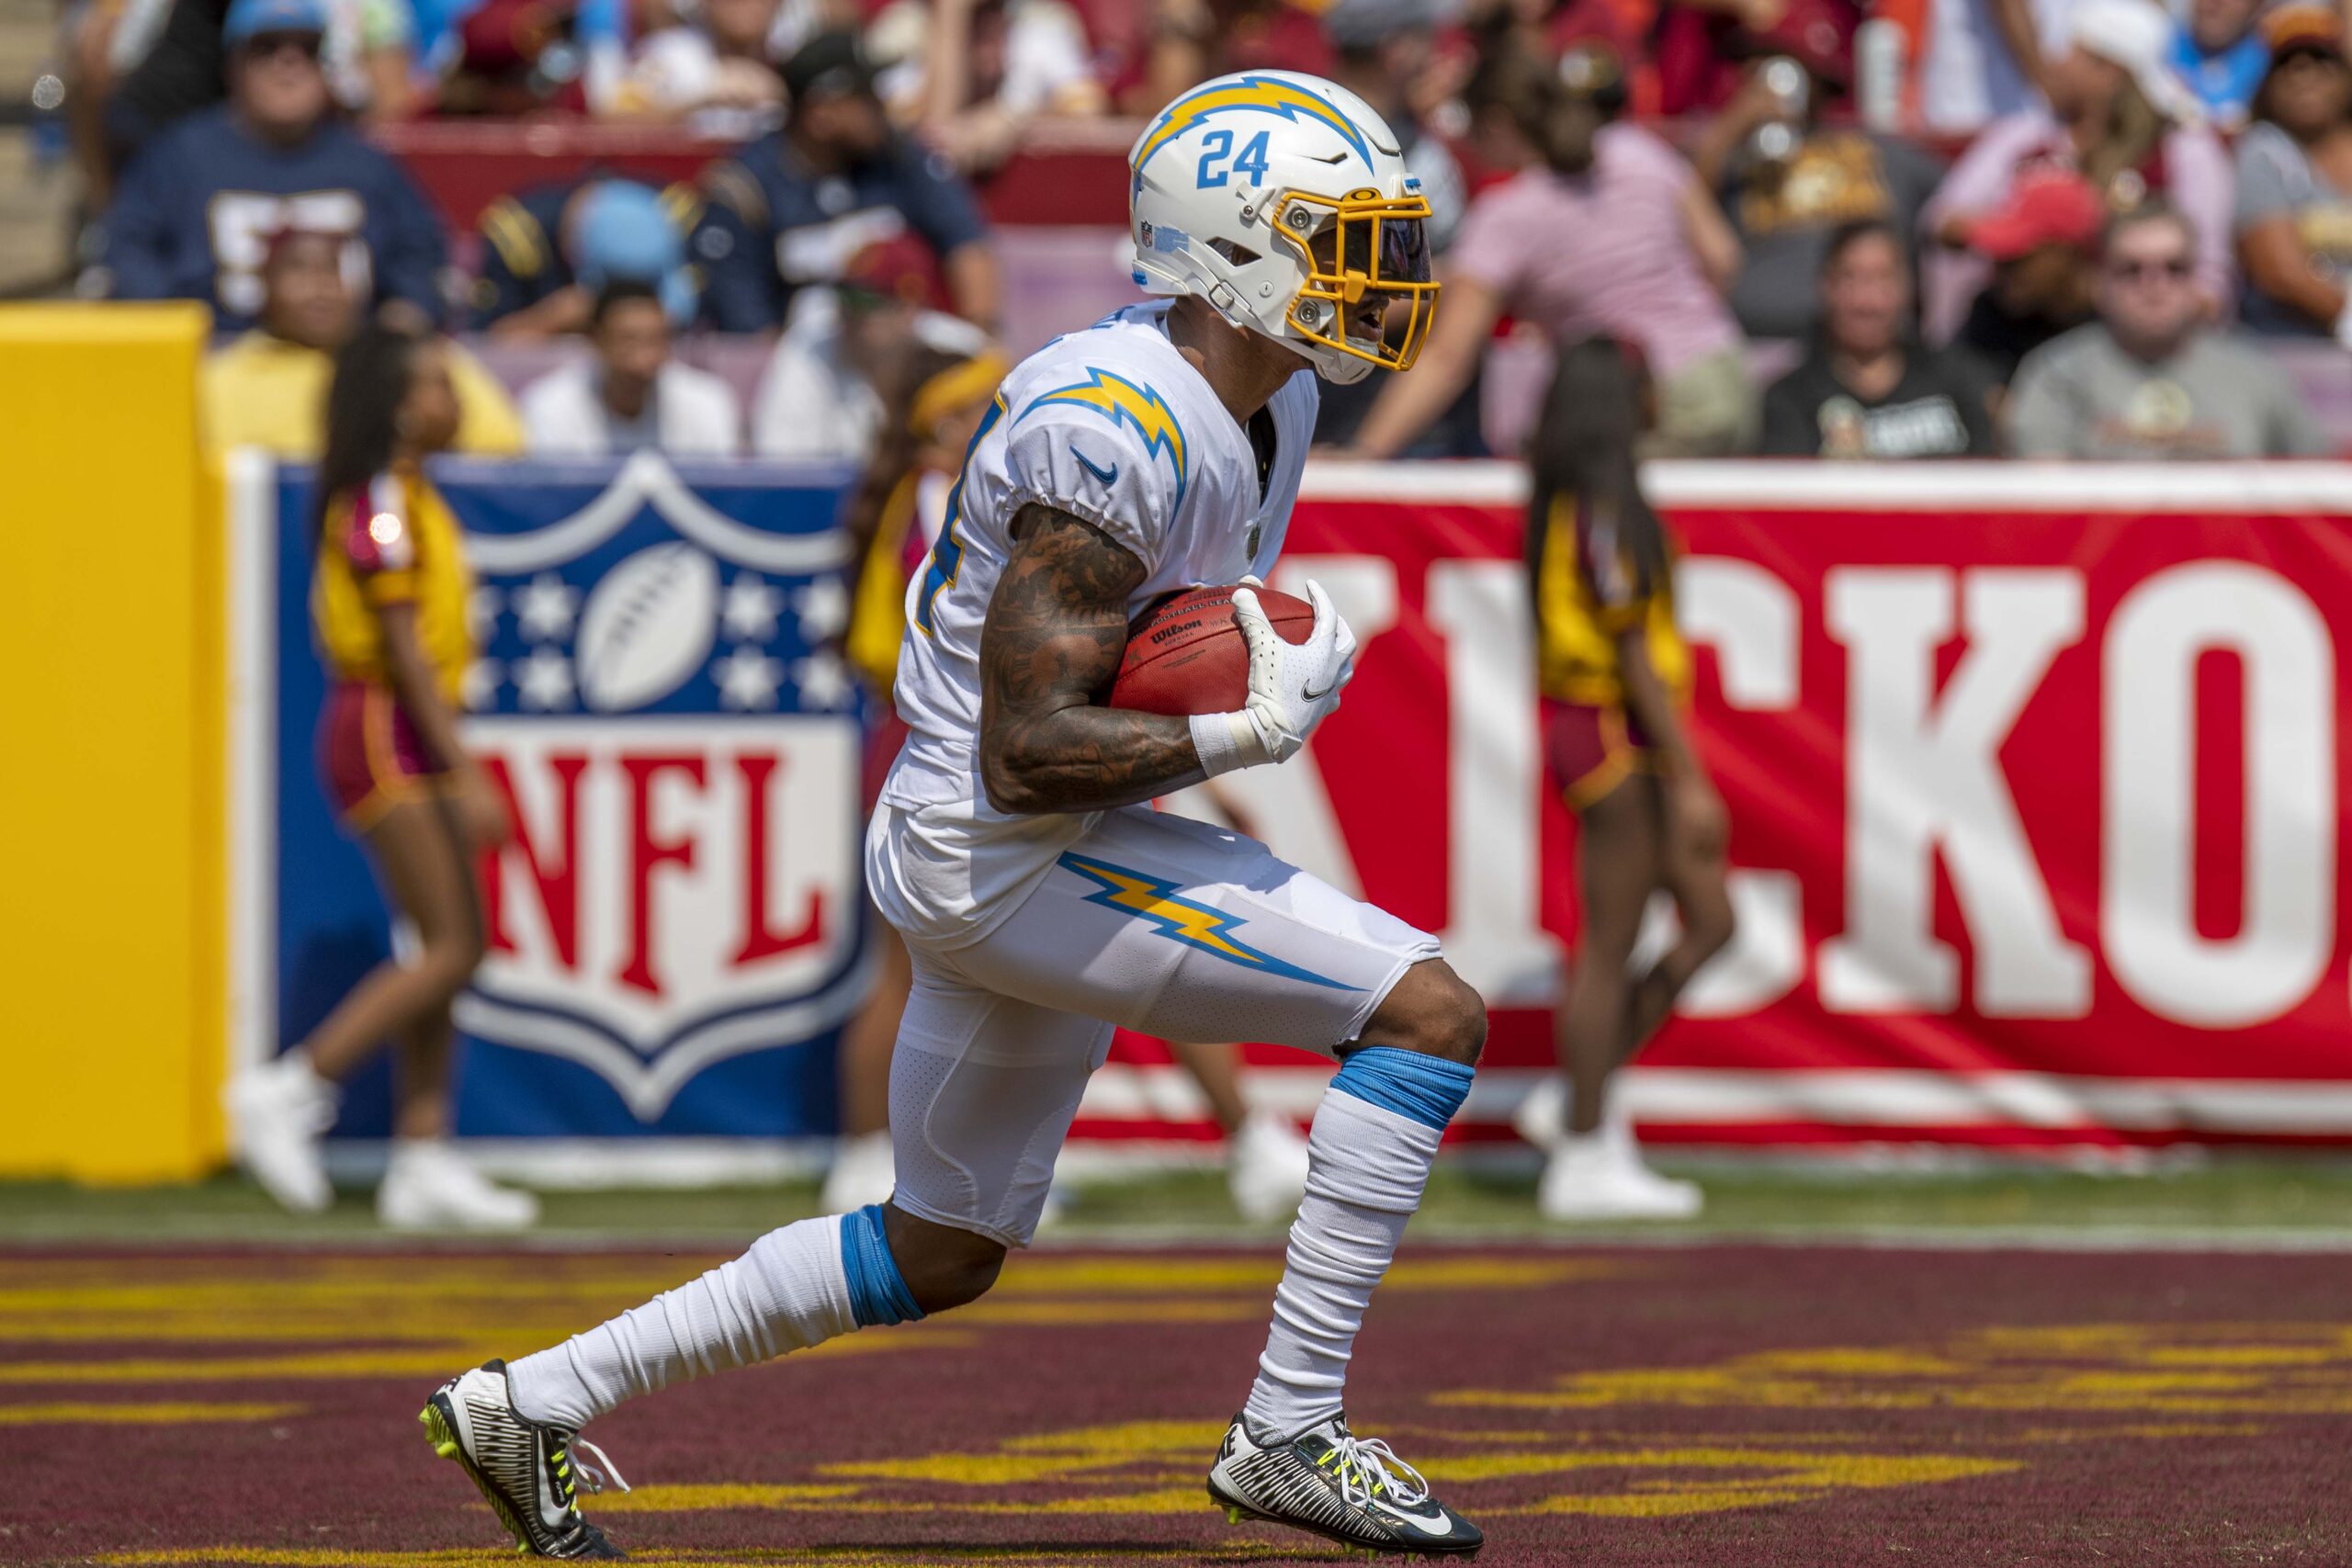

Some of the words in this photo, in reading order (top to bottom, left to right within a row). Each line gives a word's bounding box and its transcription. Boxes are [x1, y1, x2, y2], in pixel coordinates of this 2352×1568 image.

[1196, 129, 1270, 190] 24
[1150, 602, 1205, 627] FOOTBALL
[1150, 618, 1203, 645] Wilson
[474, 748, 823, 1002] NFL
